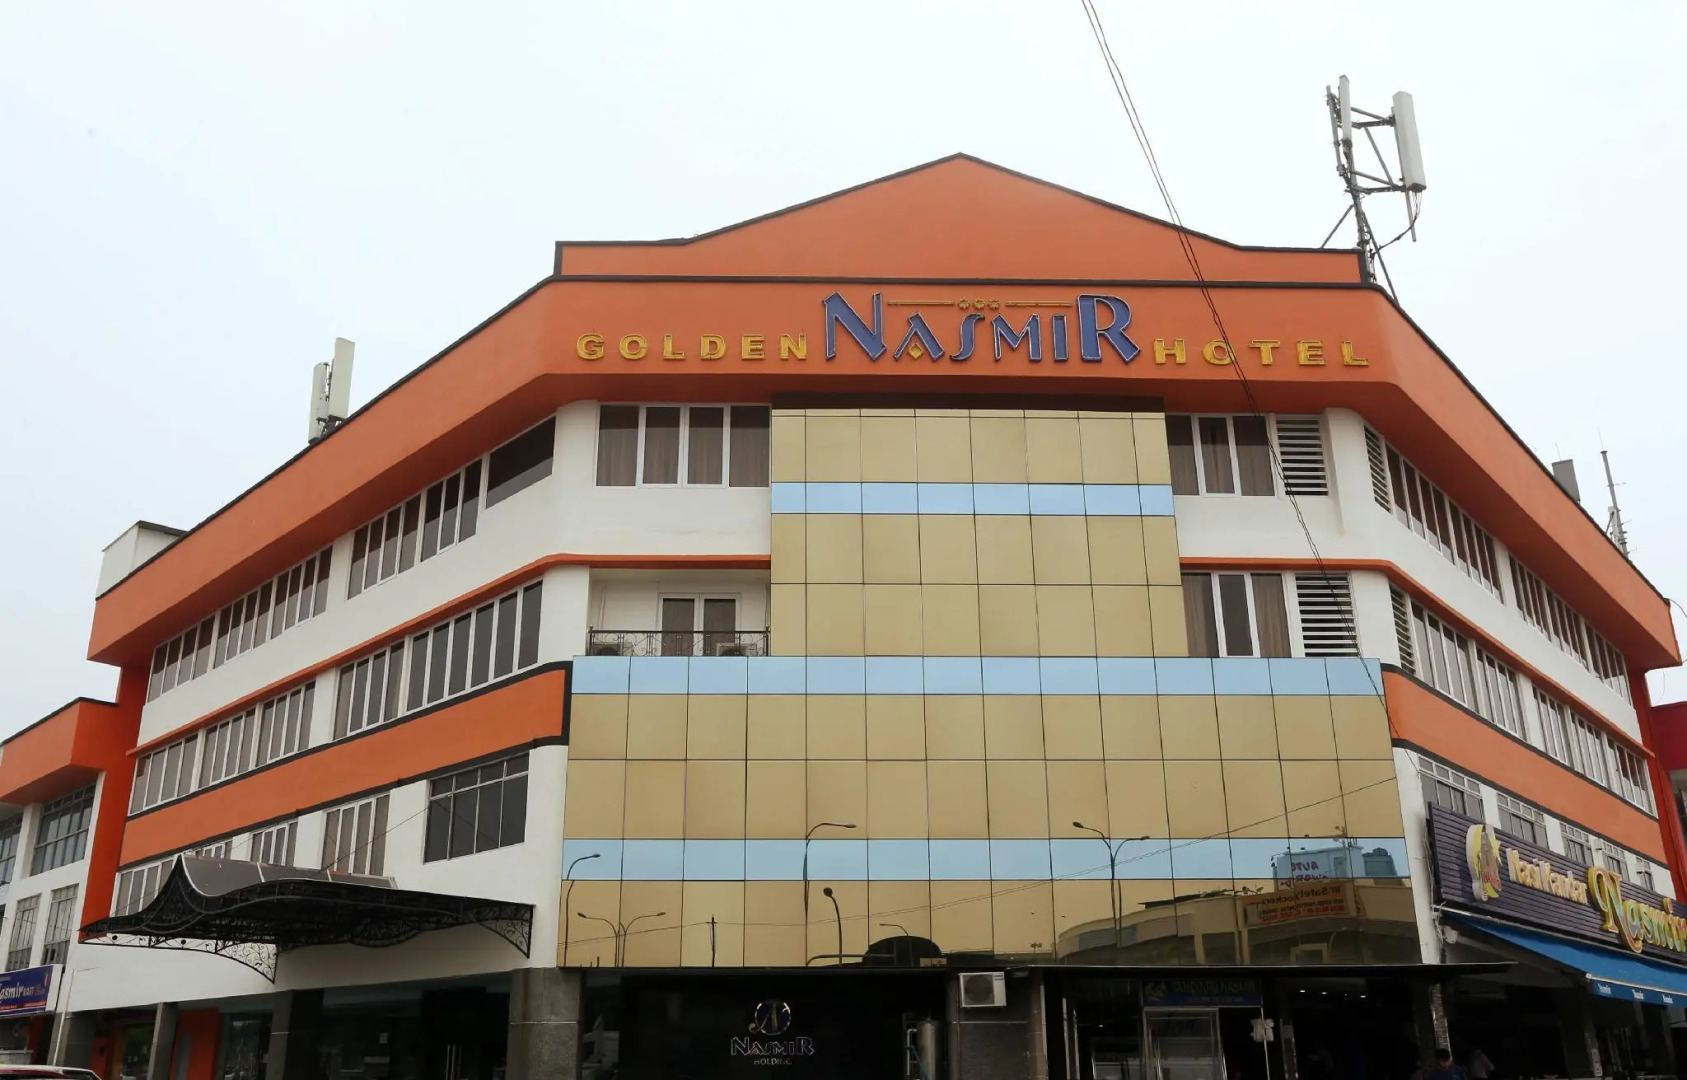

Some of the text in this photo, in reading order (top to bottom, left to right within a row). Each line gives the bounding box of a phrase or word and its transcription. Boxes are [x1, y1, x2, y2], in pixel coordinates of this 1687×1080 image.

[577, 291, 1369, 366] GOLDEN NASMIR HOTEL
[730, 1036, 815, 1056] NASMIR
